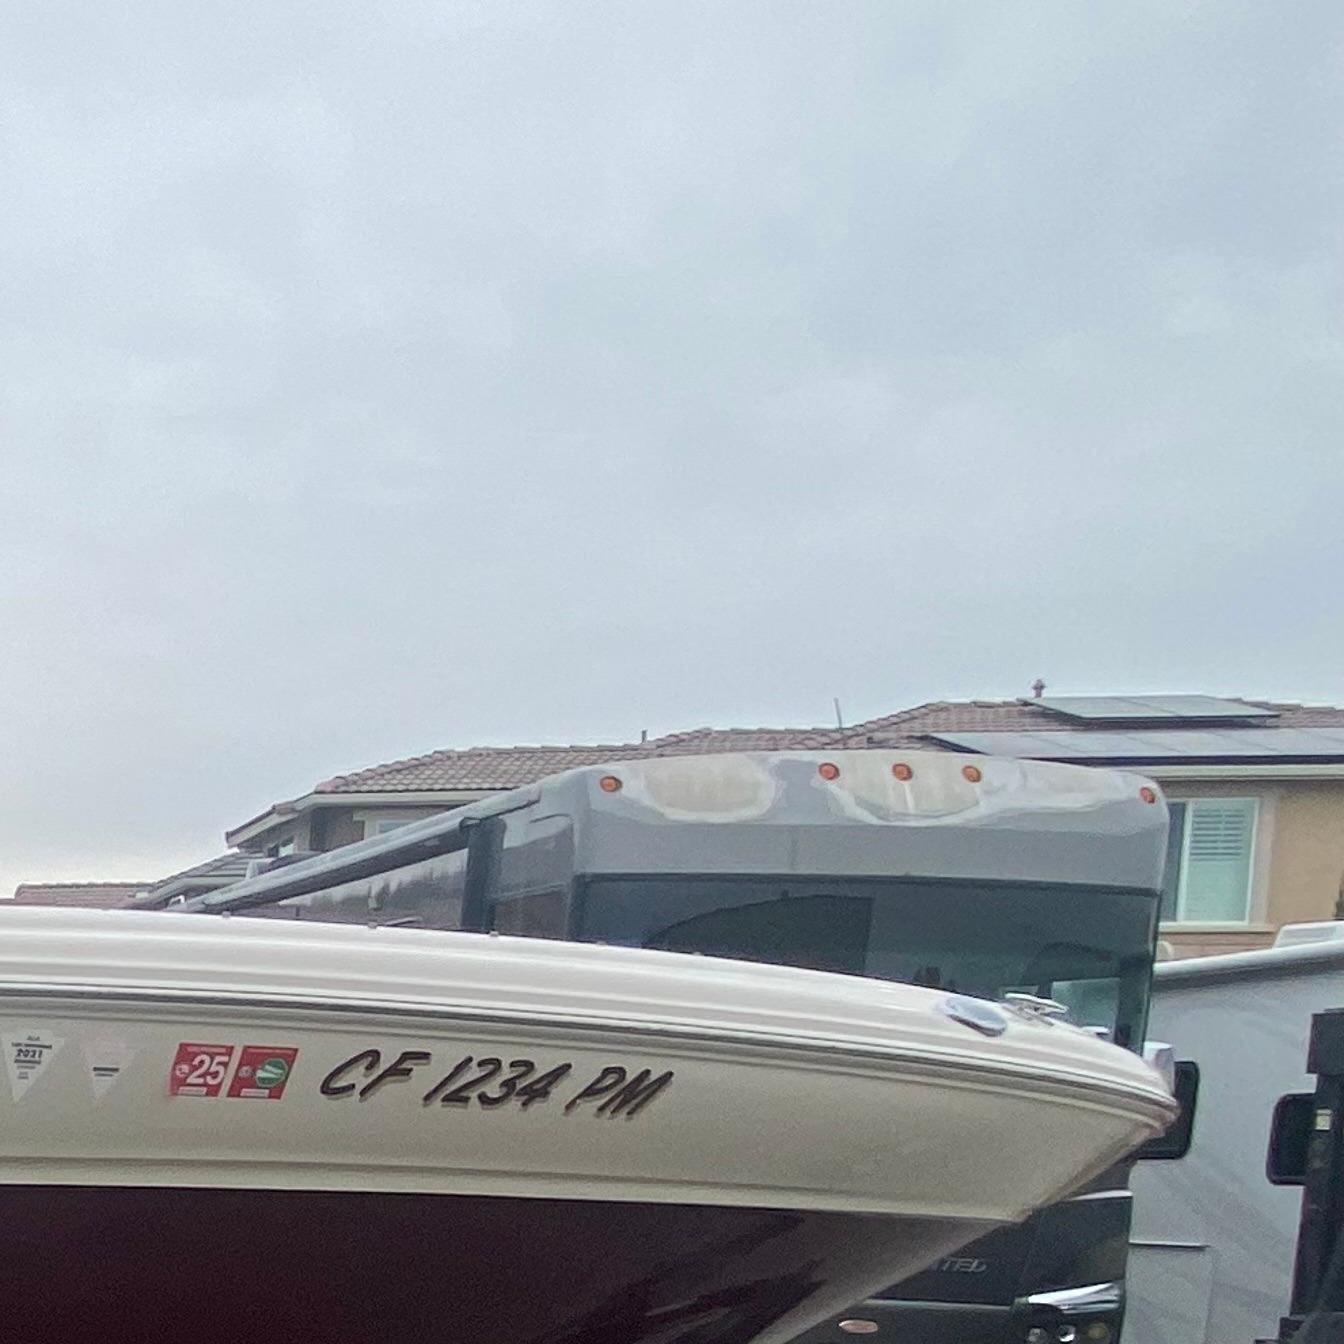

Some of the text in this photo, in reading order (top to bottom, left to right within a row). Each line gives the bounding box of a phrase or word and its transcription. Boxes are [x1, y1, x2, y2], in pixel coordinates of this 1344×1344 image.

[15, 1048, 43, 1059] 2021
[185, 1053, 229, 1086] 25
[319, 1047, 675, 1117] CF 1234 PM
